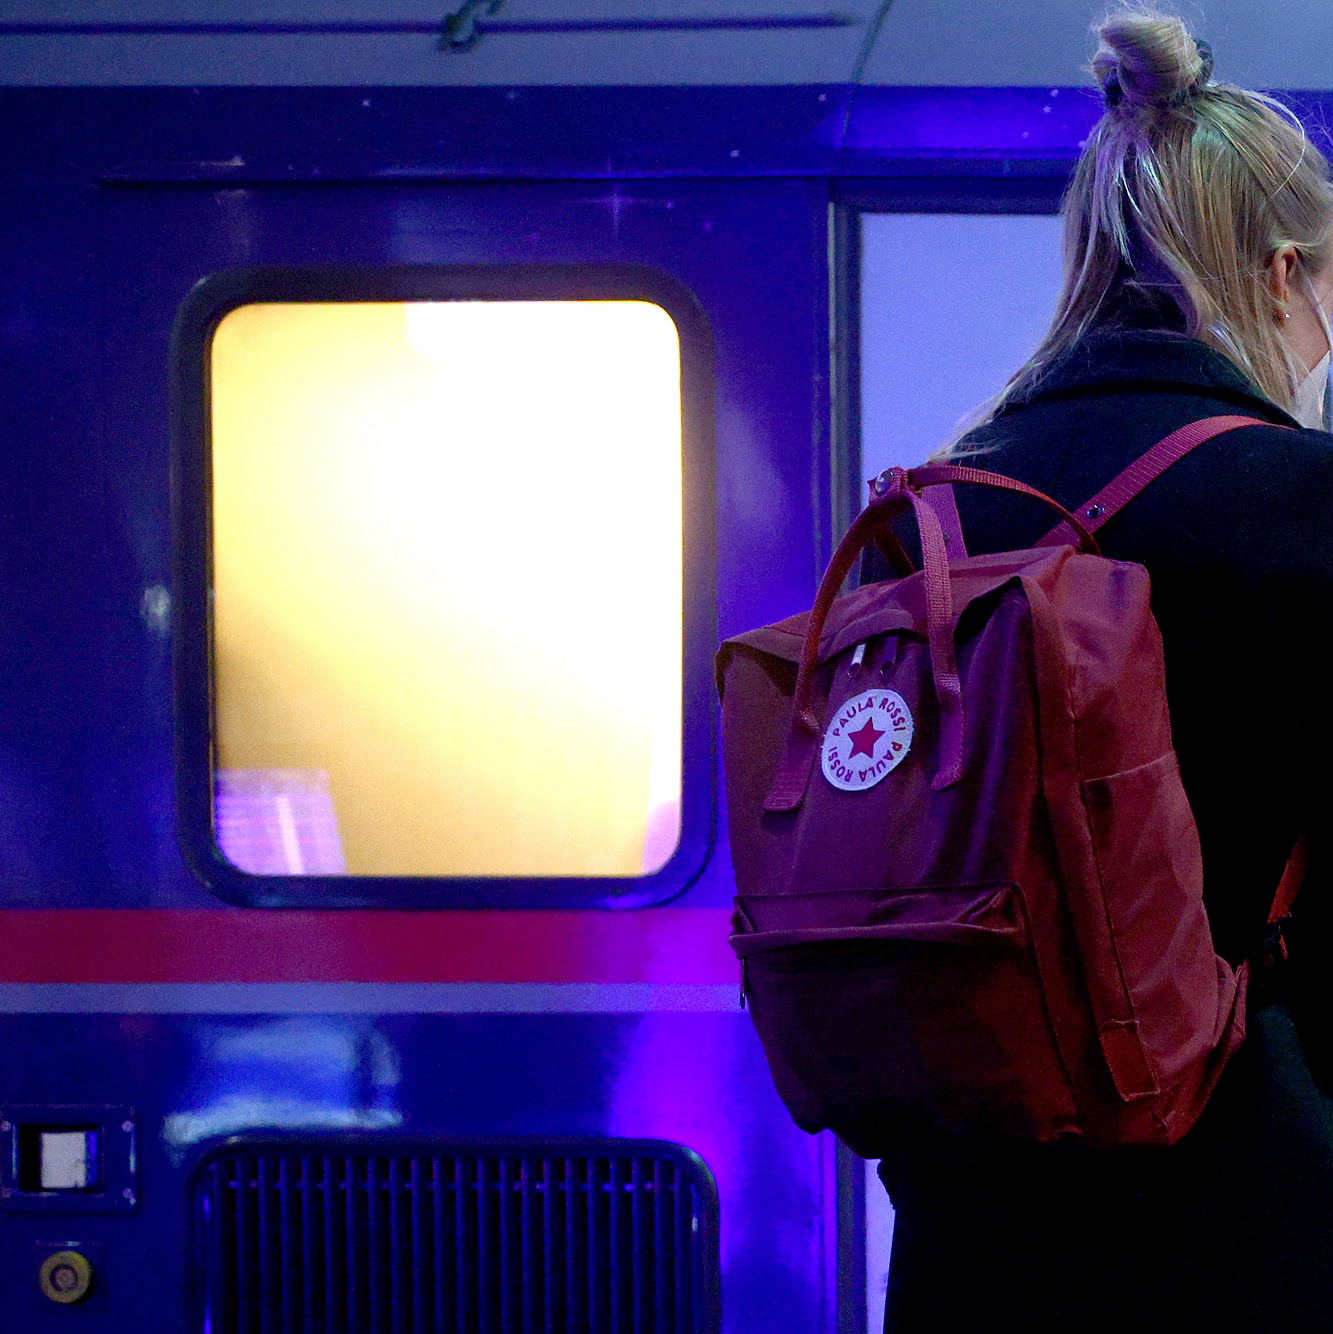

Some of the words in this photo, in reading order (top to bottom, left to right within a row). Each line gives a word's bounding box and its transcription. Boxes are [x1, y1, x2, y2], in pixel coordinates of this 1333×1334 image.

[832, 697, 874, 737] PAULA
[878, 697, 906, 732] ROSSI
[828, 746, 853, 783] ROSSI
[858, 741, 903, 783] PAULA
